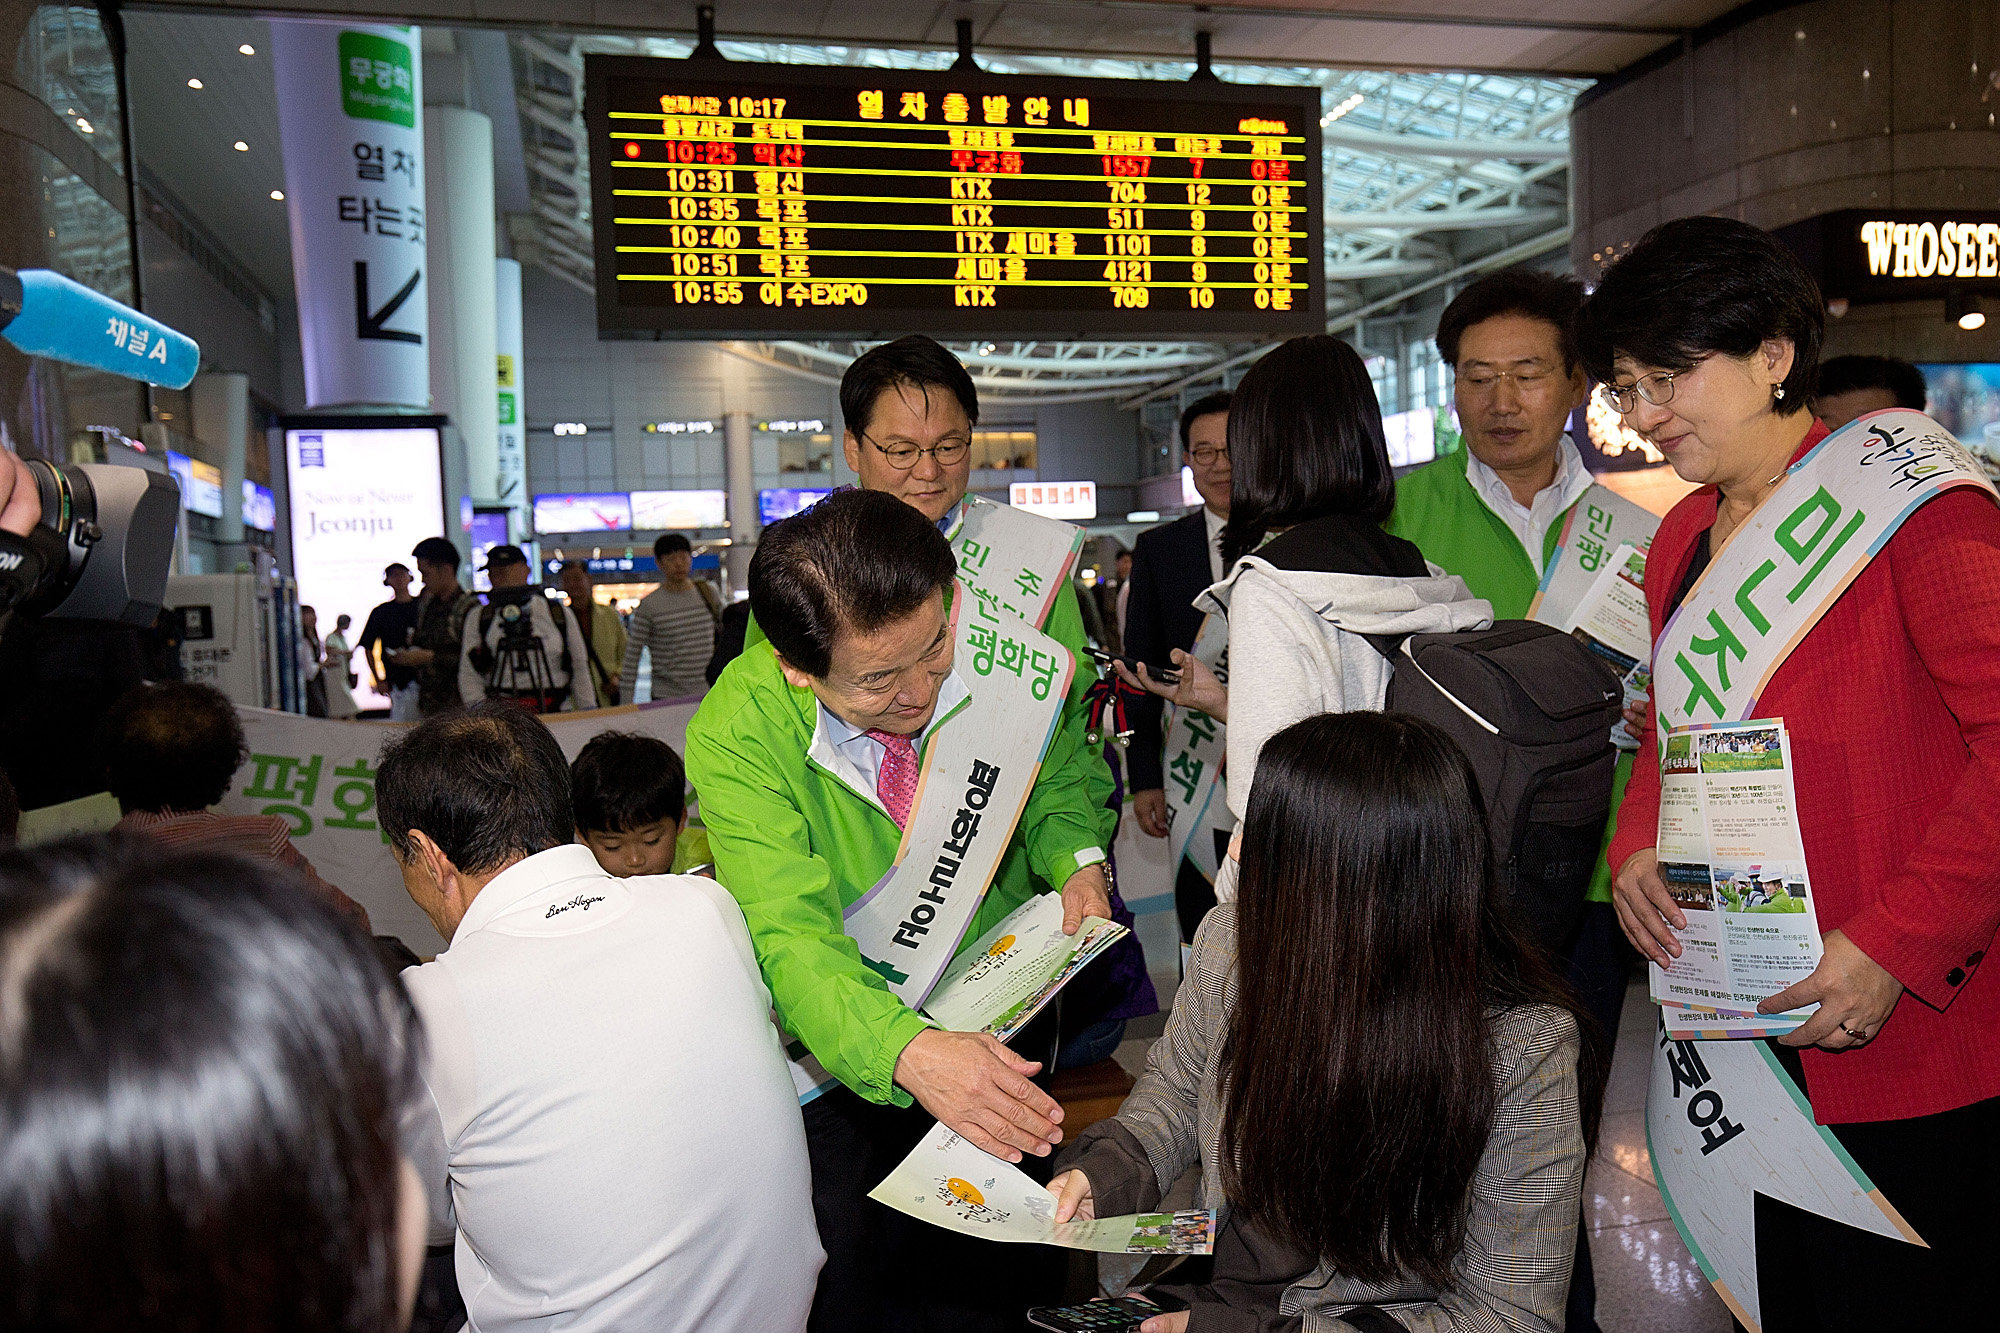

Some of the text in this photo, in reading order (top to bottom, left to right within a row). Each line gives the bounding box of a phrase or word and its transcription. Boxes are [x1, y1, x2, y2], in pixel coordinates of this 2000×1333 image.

[728, 97, 786, 118] 10:17
[354, 142, 415, 186] 열차
[665, 140, 737, 165] 10:25
[753, 143, 805, 167] 익산
[950, 150, 1024, 174] 무궁화
[1102, 155, 1151, 177] 1557
[1189, 157, 1204, 179] 7
[667, 168, 734, 193] 10:31
[753, 171, 804, 196] 행신
[950, 178, 993, 199] KTX
[1106, 182, 1147, 203] 704
[1186, 184, 1211, 205] 12
[668, 197, 740, 221] 10:35
[756, 198, 808, 223] 목포
[951, 205, 994, 227] KTX
[1107, 208, 1145, 229] 511
[1190, 210, 1205, 231] 9
[669, 225, 741, 249] 10:40
[757, 226, 810, 251] 목포
[955, 232, 995, 253] ITX
[1104, 234, 1151, 256] 1101
[1191, 235, 1206, 257] 8
[1861, 221, 2000, 278] WHOSEE
[671, 253, 738, 277] 10:51
[758, 253, 811, 279] 목포
[1103, 261, 1152, 282] 4121
[1191, 262, 1207, 283] 9
[672, 281, 744, 305] 10:55
[954, 286, 996, 307] KTX
[1109, 287, 1149, 309] 709
[1189, 287, 1215, 309] 10
[1860, 424, 1954, 492] 한가위
[966, 623, 1060, 702] 평화당
[892, 758, 1001, 950] 평화로운
[1659, 1036, 1745, 1156] 세요
